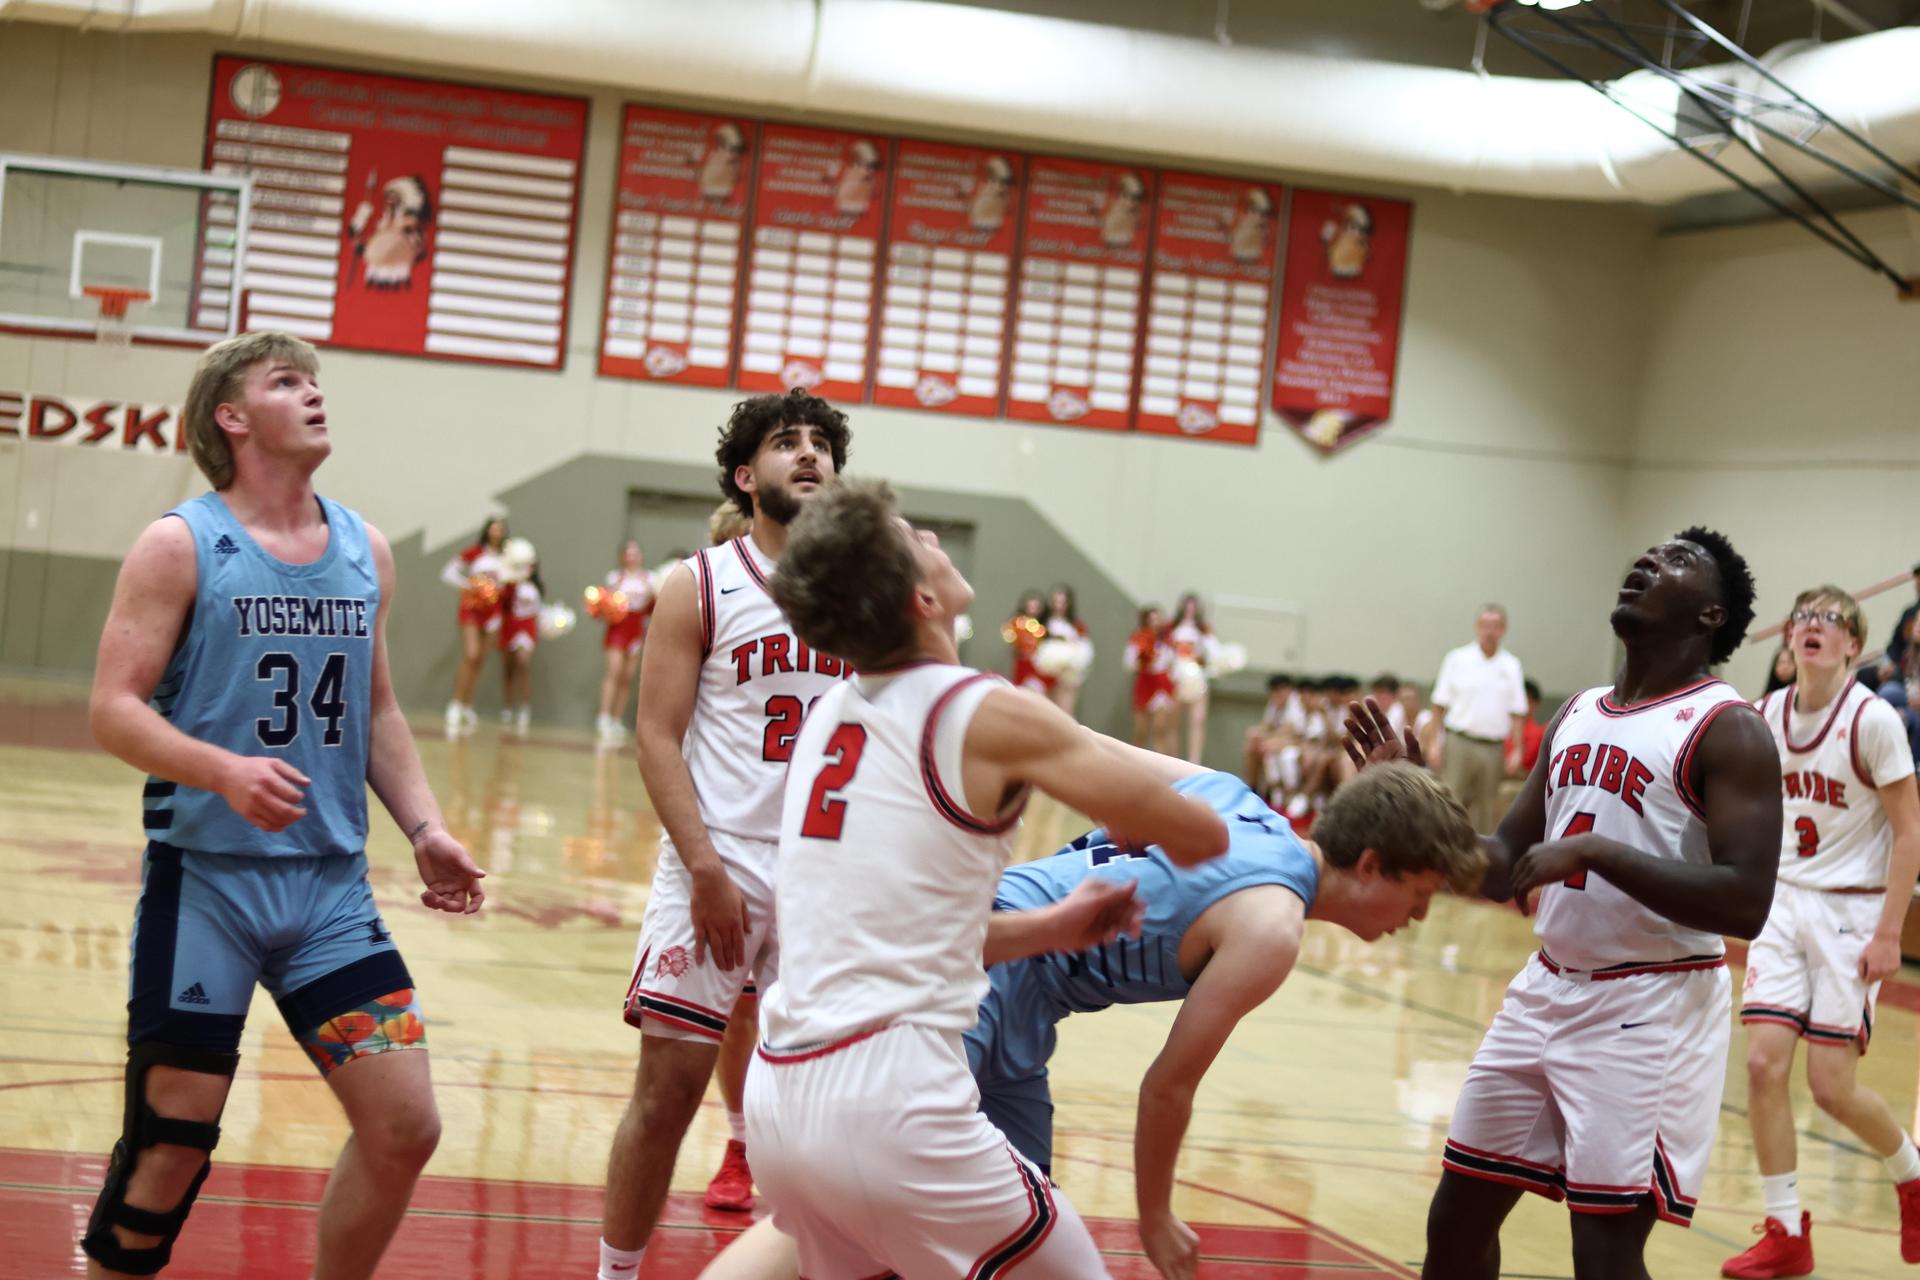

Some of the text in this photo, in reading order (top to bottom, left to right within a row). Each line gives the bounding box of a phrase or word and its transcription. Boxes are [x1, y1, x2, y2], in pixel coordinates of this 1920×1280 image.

[233, 595, 369, 638] YOSEMITE
[256, 651, 348, 748] 34
[800, 722, 868, 841] 2
[1794, 816, 1820, 858] 3
